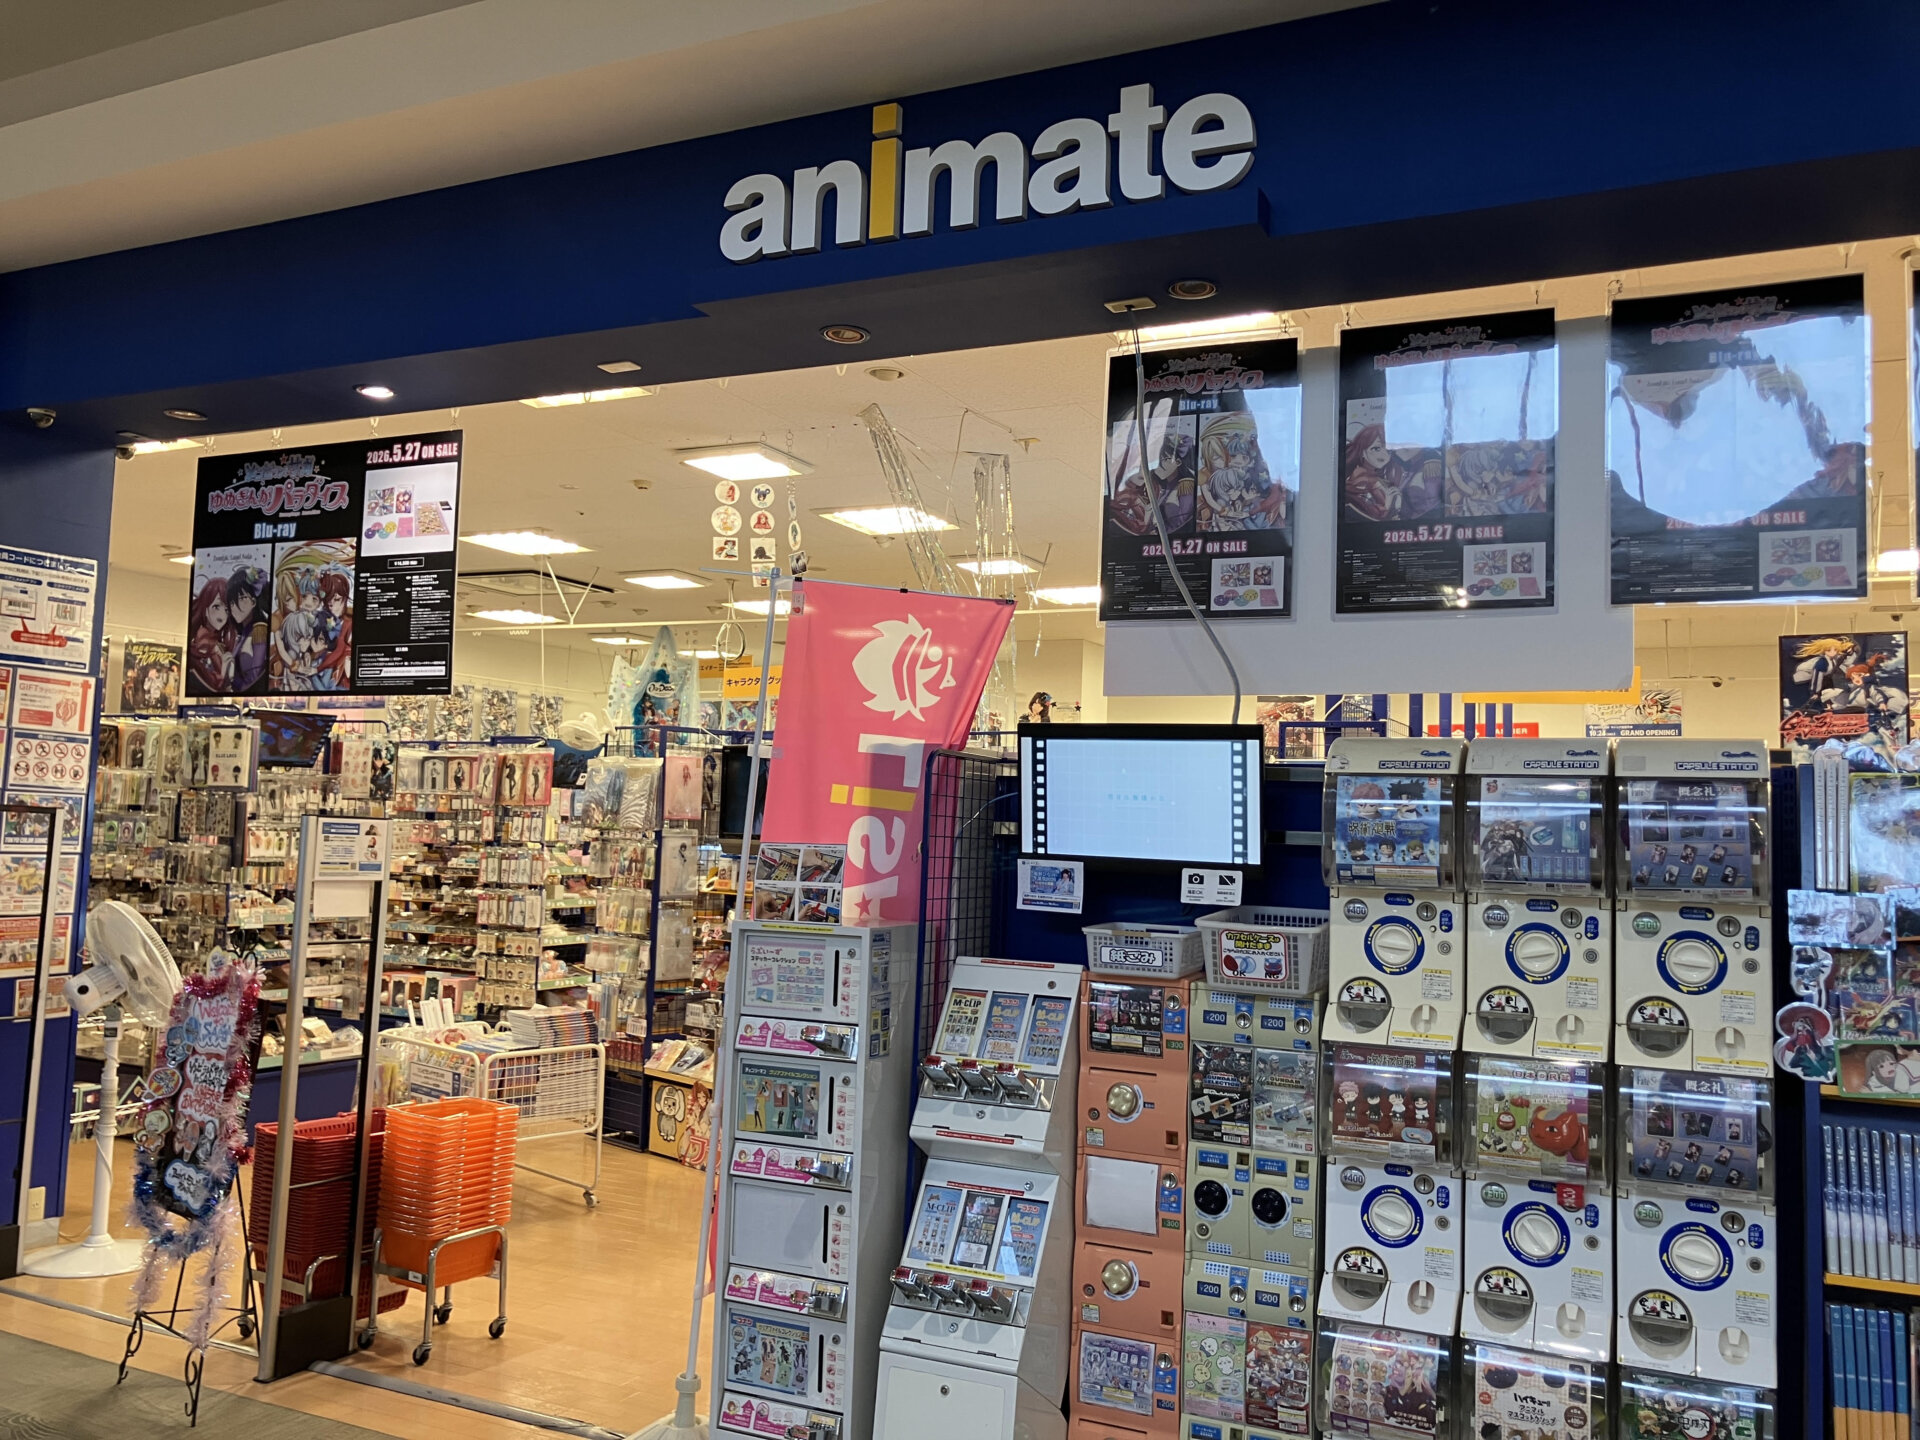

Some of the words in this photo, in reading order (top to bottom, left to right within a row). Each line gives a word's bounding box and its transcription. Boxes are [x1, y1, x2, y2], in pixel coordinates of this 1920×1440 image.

[720, 82, 1257, 263] animate
[367, 442, 421, 464] 2026.5.27
[422, 445, 435, 458] ON
[436, 442, 459, 456] SALE
[1773, 511, 1805, 524] SALE
[254, 522, 296, 539] Blu-ray
[1384, 525, 1452, 543] 2026.5.27
[1457, 528, 1473, 539] ON
[1475, 526, 1503, 538] SALE
[1206, 541, 1221, 553] ON
[1222, 540, 1248, 552] SALE
[1676, 762, 1718, 770] CAPSULE
[1719, 762, 1758, 770] STATION
[1226, 932, 1280, 943] カプセルケースは
[1109, 949, 1156, 964] 紙ごみ
[1265, 971, 1279, 979] NG
[953, 999, 981, 1008] M-CLIP
[1206, 1013, 1225, 1022] ¥200
[1264, 1019, 1284, 1028] ¥200
[1204, 1080, 1240, 1088] SELECTION
[1266, 1081, 1304, 1090] SELECTION
[1343, 1173, 1363, 1184] ¥400
[926, 1202, 956, 1214] M-CLIP
[1638, 1207, 1660, 1219] ¥300
[1199, 1284, 1219, 1294] ¥200
[1258, 1294, 1278, 1303] ¥200
[1520, 1405, 1545, 1415] アニマル
